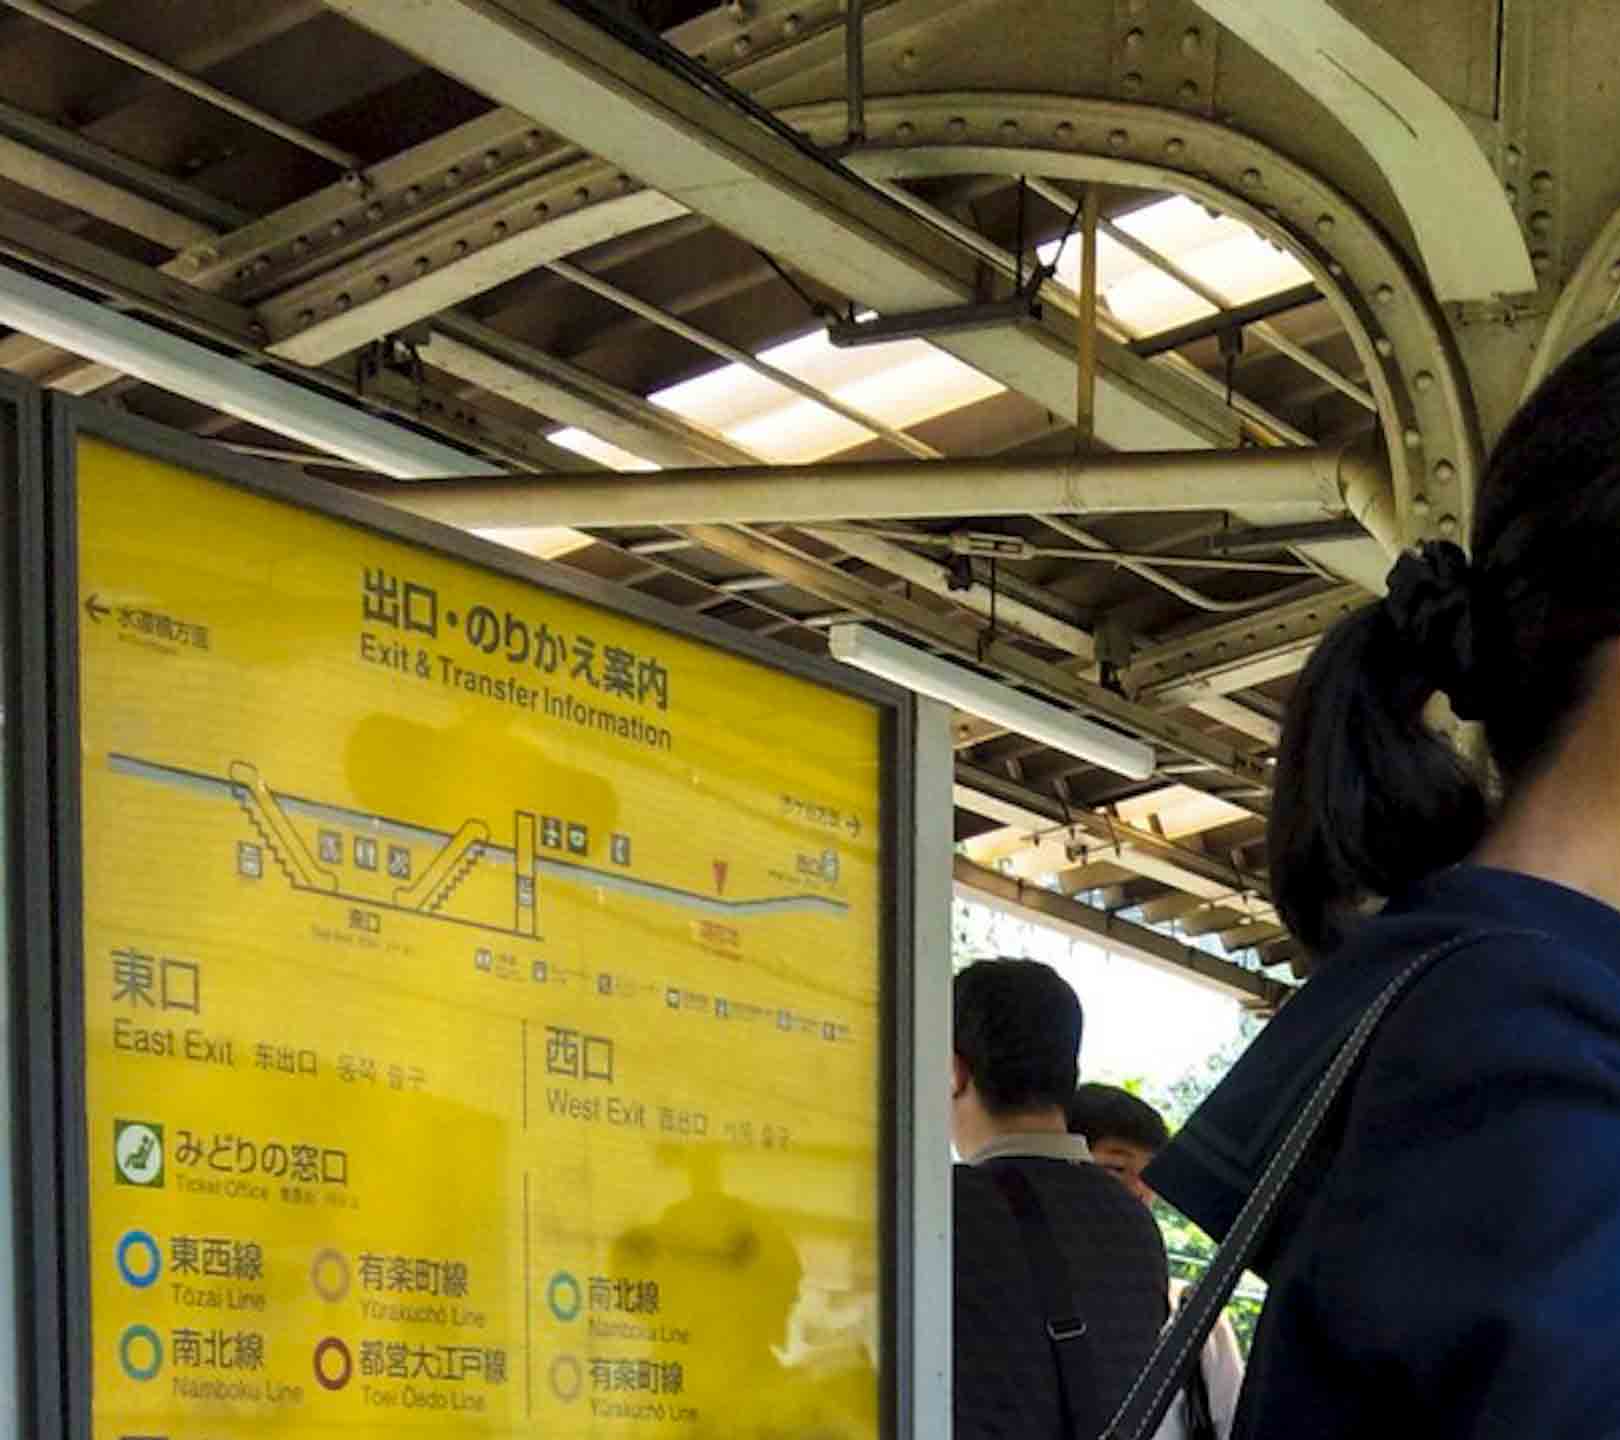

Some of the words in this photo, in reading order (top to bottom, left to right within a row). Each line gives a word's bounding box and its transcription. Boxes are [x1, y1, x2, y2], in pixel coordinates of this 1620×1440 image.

[363, 568, 669, 712] 出口・のりかえ案内
[361, 632, 408, 677] Exit
[415, 652, 431, 678] &
[437, 656, 539, 707] Transfer
[545, 687, 672, 750] Information
[111, 946, 201, 1016] 東口
[113, 1017, 174, 1057] East
[185, 1029, 233, 1067] Exit
[544, 1023, 614, 1082] 西口
[546, 1086, 600, 1122] West
[607, 1097, 646, 1130] Exit
[175, 1130, 349, 1188] みどりの窓口
[170, 1235, 264, 1282] 東西線
[357, 1251, 470, 1298] 有楽町線
[227, 1288, 267, 1314] Line
[588, 1275, 661, 1315] 南北線
[171, 1327, 264, 1372] 南北線
[358, 1340, 509, 1385] 都営大江戸線
[588, 1356, 685, 1396] 有楽町線
